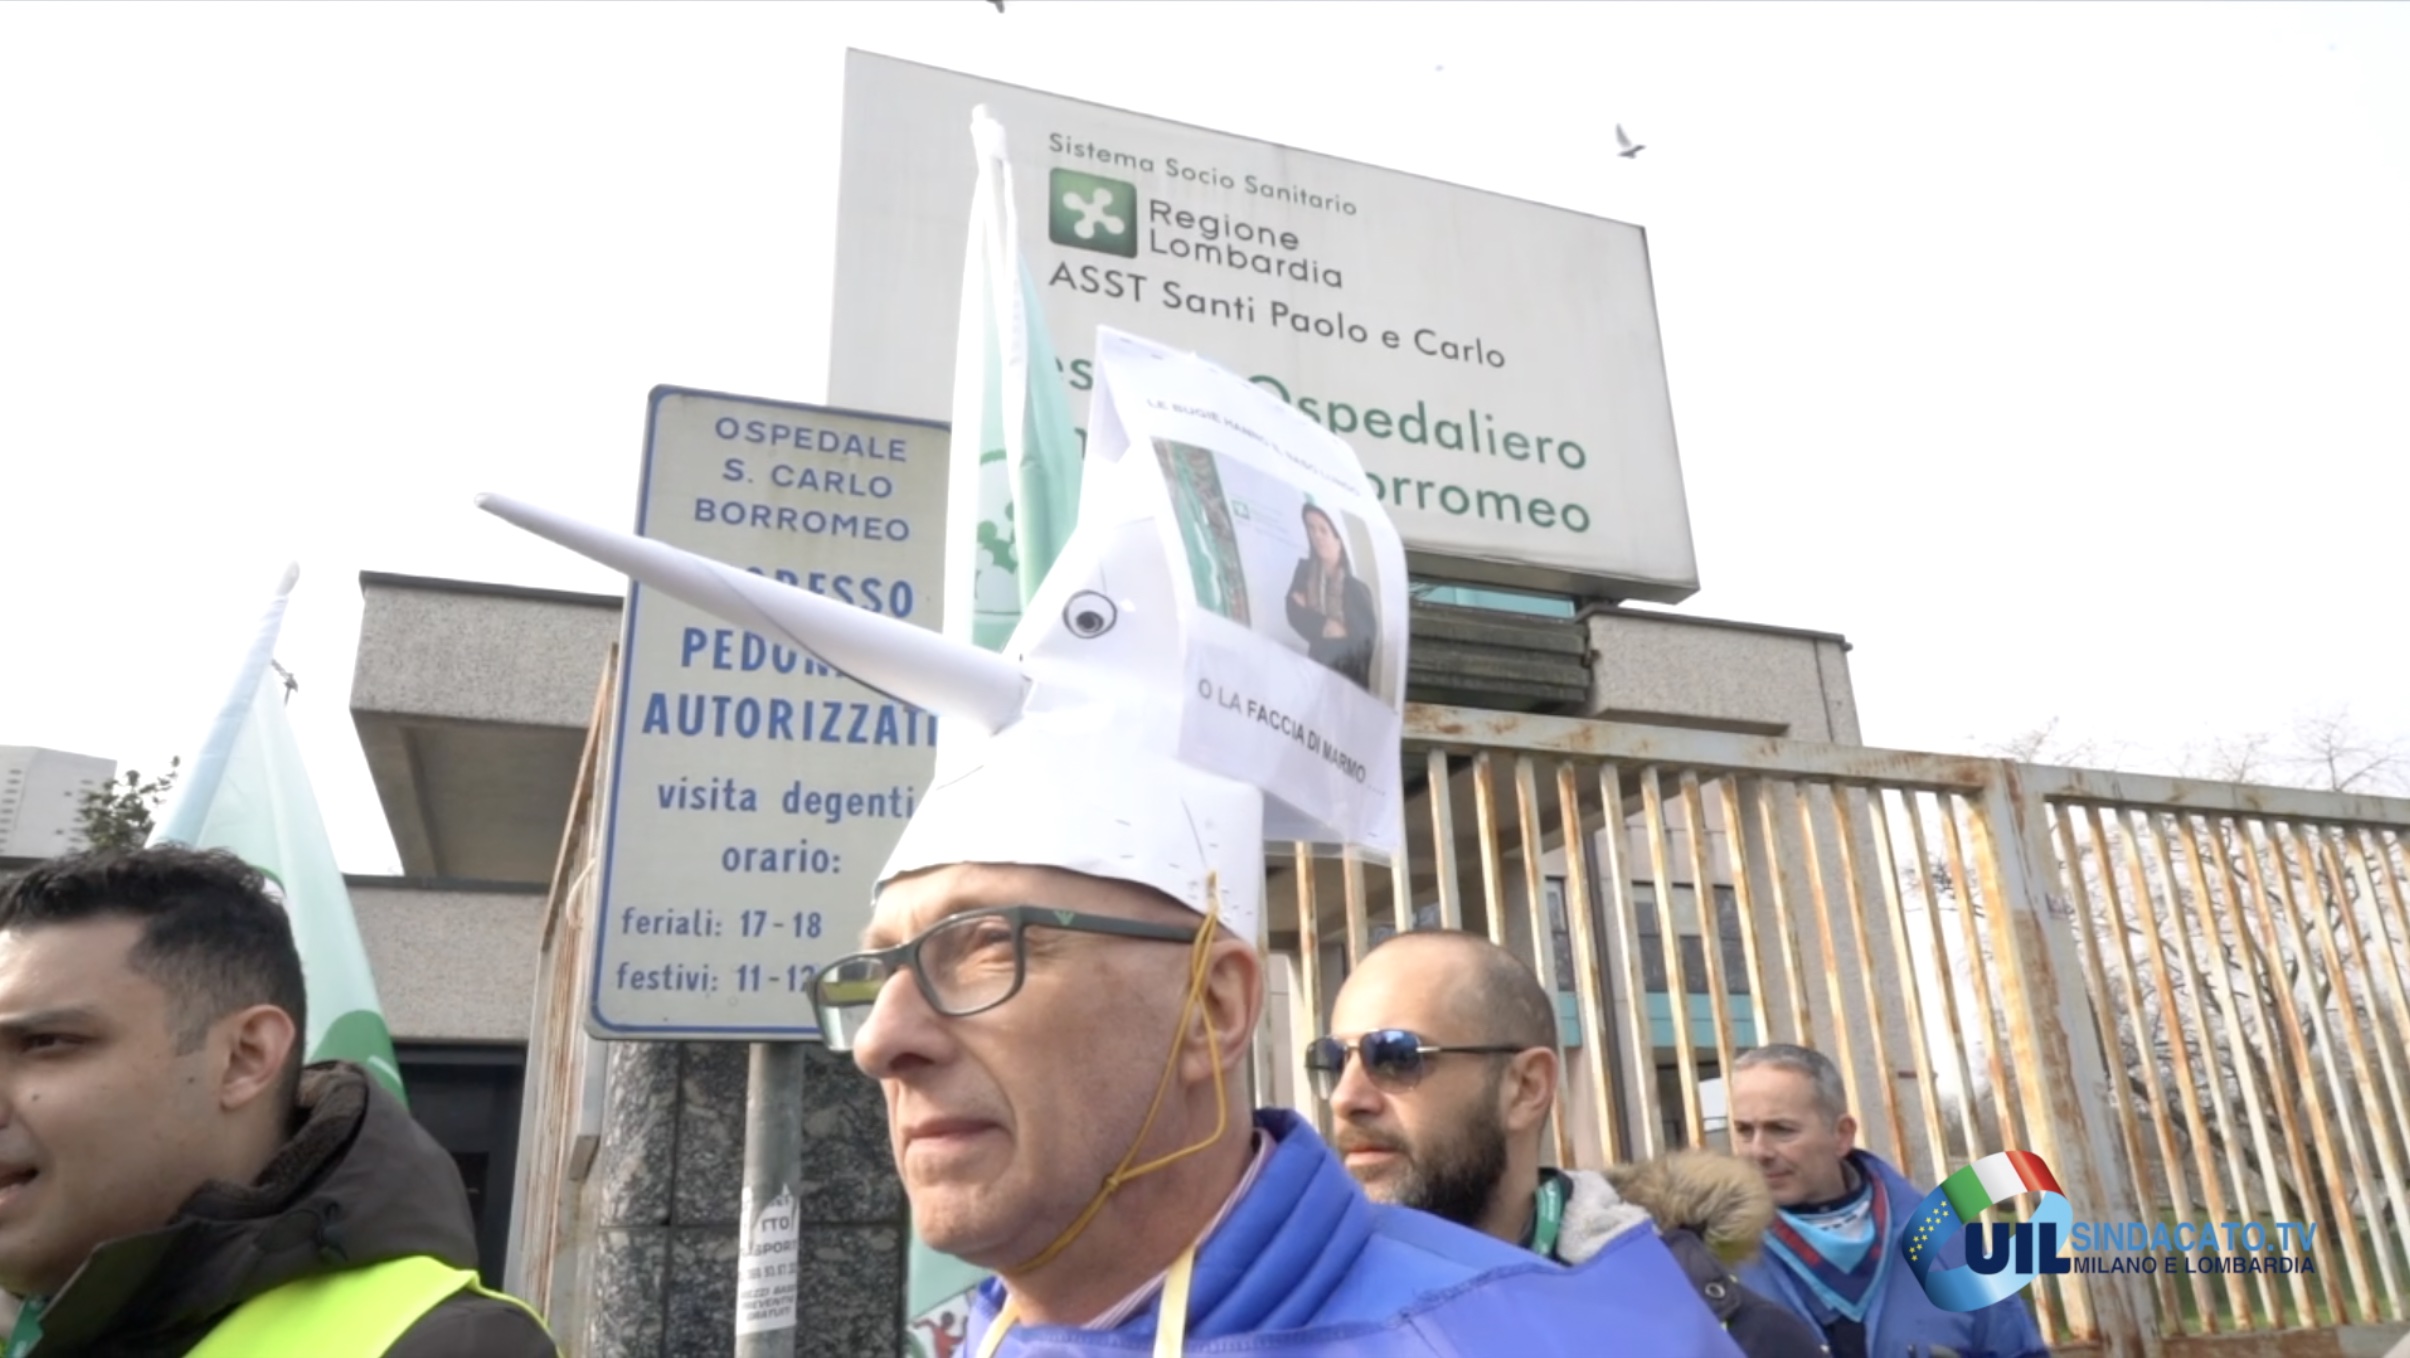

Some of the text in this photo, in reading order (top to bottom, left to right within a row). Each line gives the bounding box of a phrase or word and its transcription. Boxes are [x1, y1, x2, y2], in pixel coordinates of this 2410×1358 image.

[1049, 132, 1358, 216] Sistema Socio Sanitario
[1149, 198, 1300, 251] Regione
[1149, 228, 1343, 289] Lombardia
[1049, 261, 1506, 369] ASST Santi Paolo e Carlo
[714, 416, 908, 463] OSPEDALE
[721, 457, 894, 499] S. CARLO
[1365, 471, 1591, 534] orromeo
[693, 497, 911, 542] BORROMEO
[641, 691, 938, 748] AUTORIZZATI
[1197, 677, 1368, 785] O LA FACCIA DI MARMO
[657, 776, 915, 825] visita degenti
[720, 838, 842, 874] orario:
[621, 906, 723, 938] feriali:
[616, 961, 719, 992] festivi:
